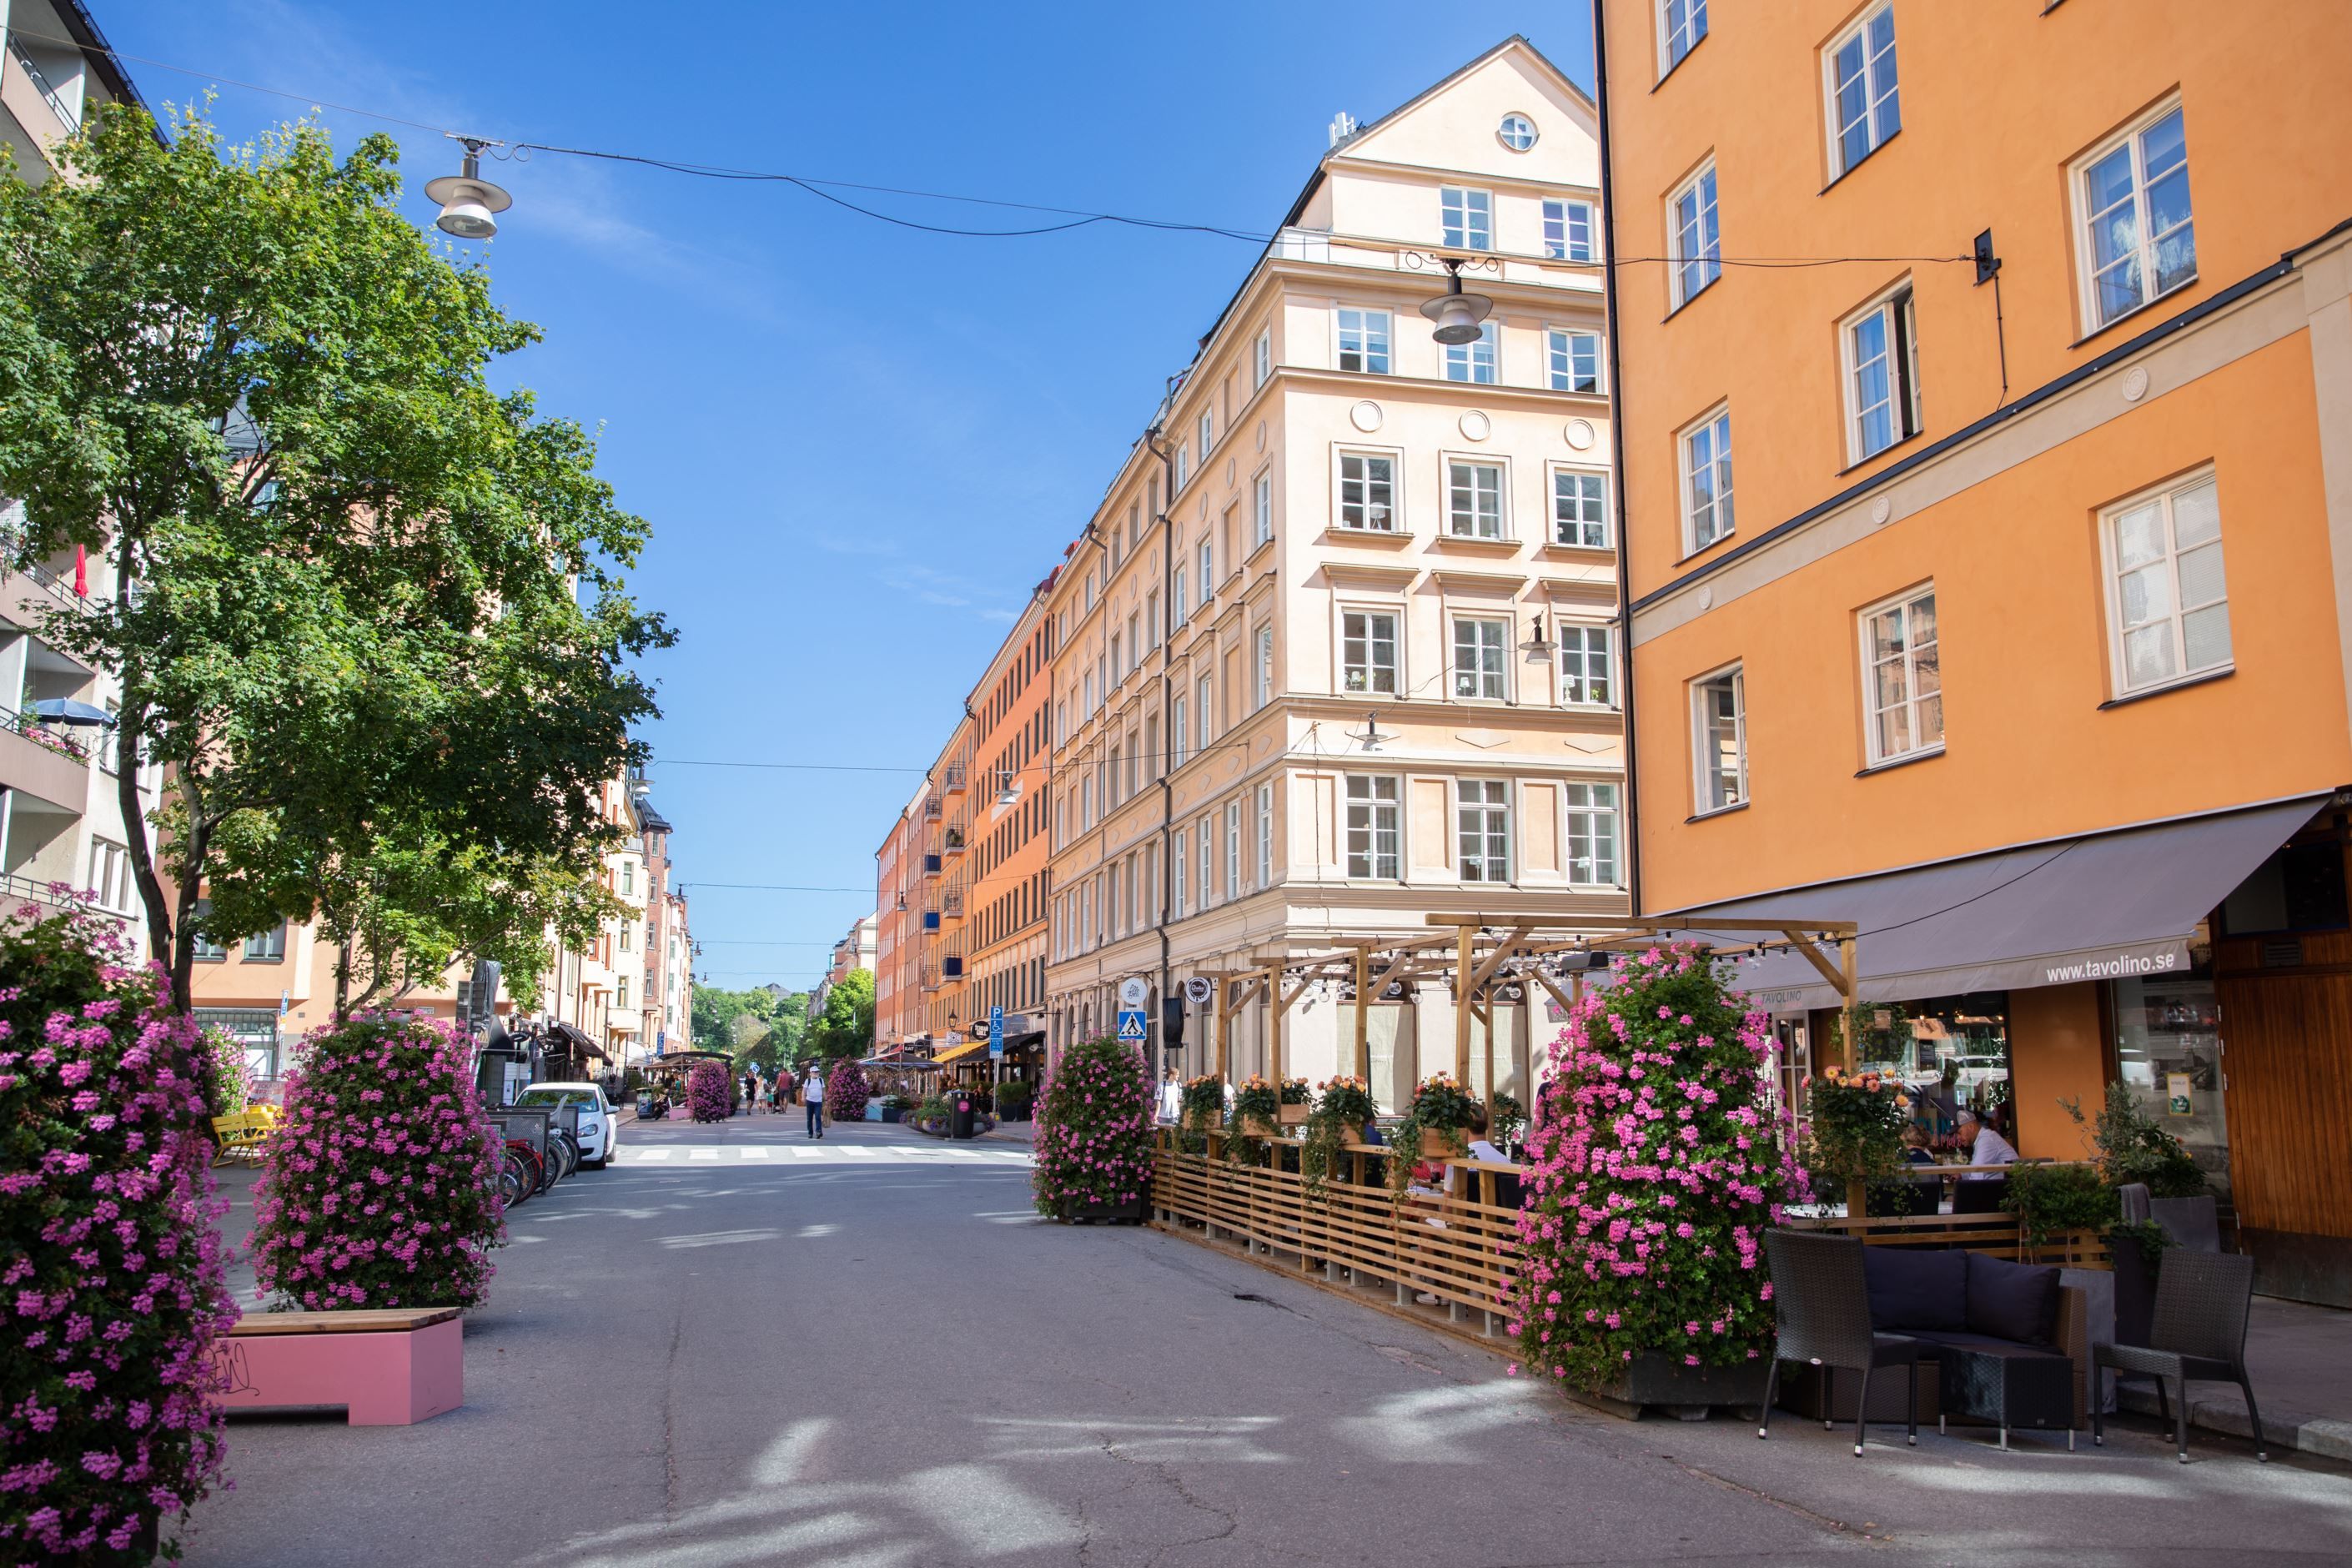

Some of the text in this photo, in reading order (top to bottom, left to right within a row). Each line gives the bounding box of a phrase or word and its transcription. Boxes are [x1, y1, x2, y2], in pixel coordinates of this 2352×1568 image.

[2046, 953, 2175, 983] www.tavolino.se
[1761, 990, 1802, 1004] TAVOLINO
[993, 1008, 1001, 1018] P
